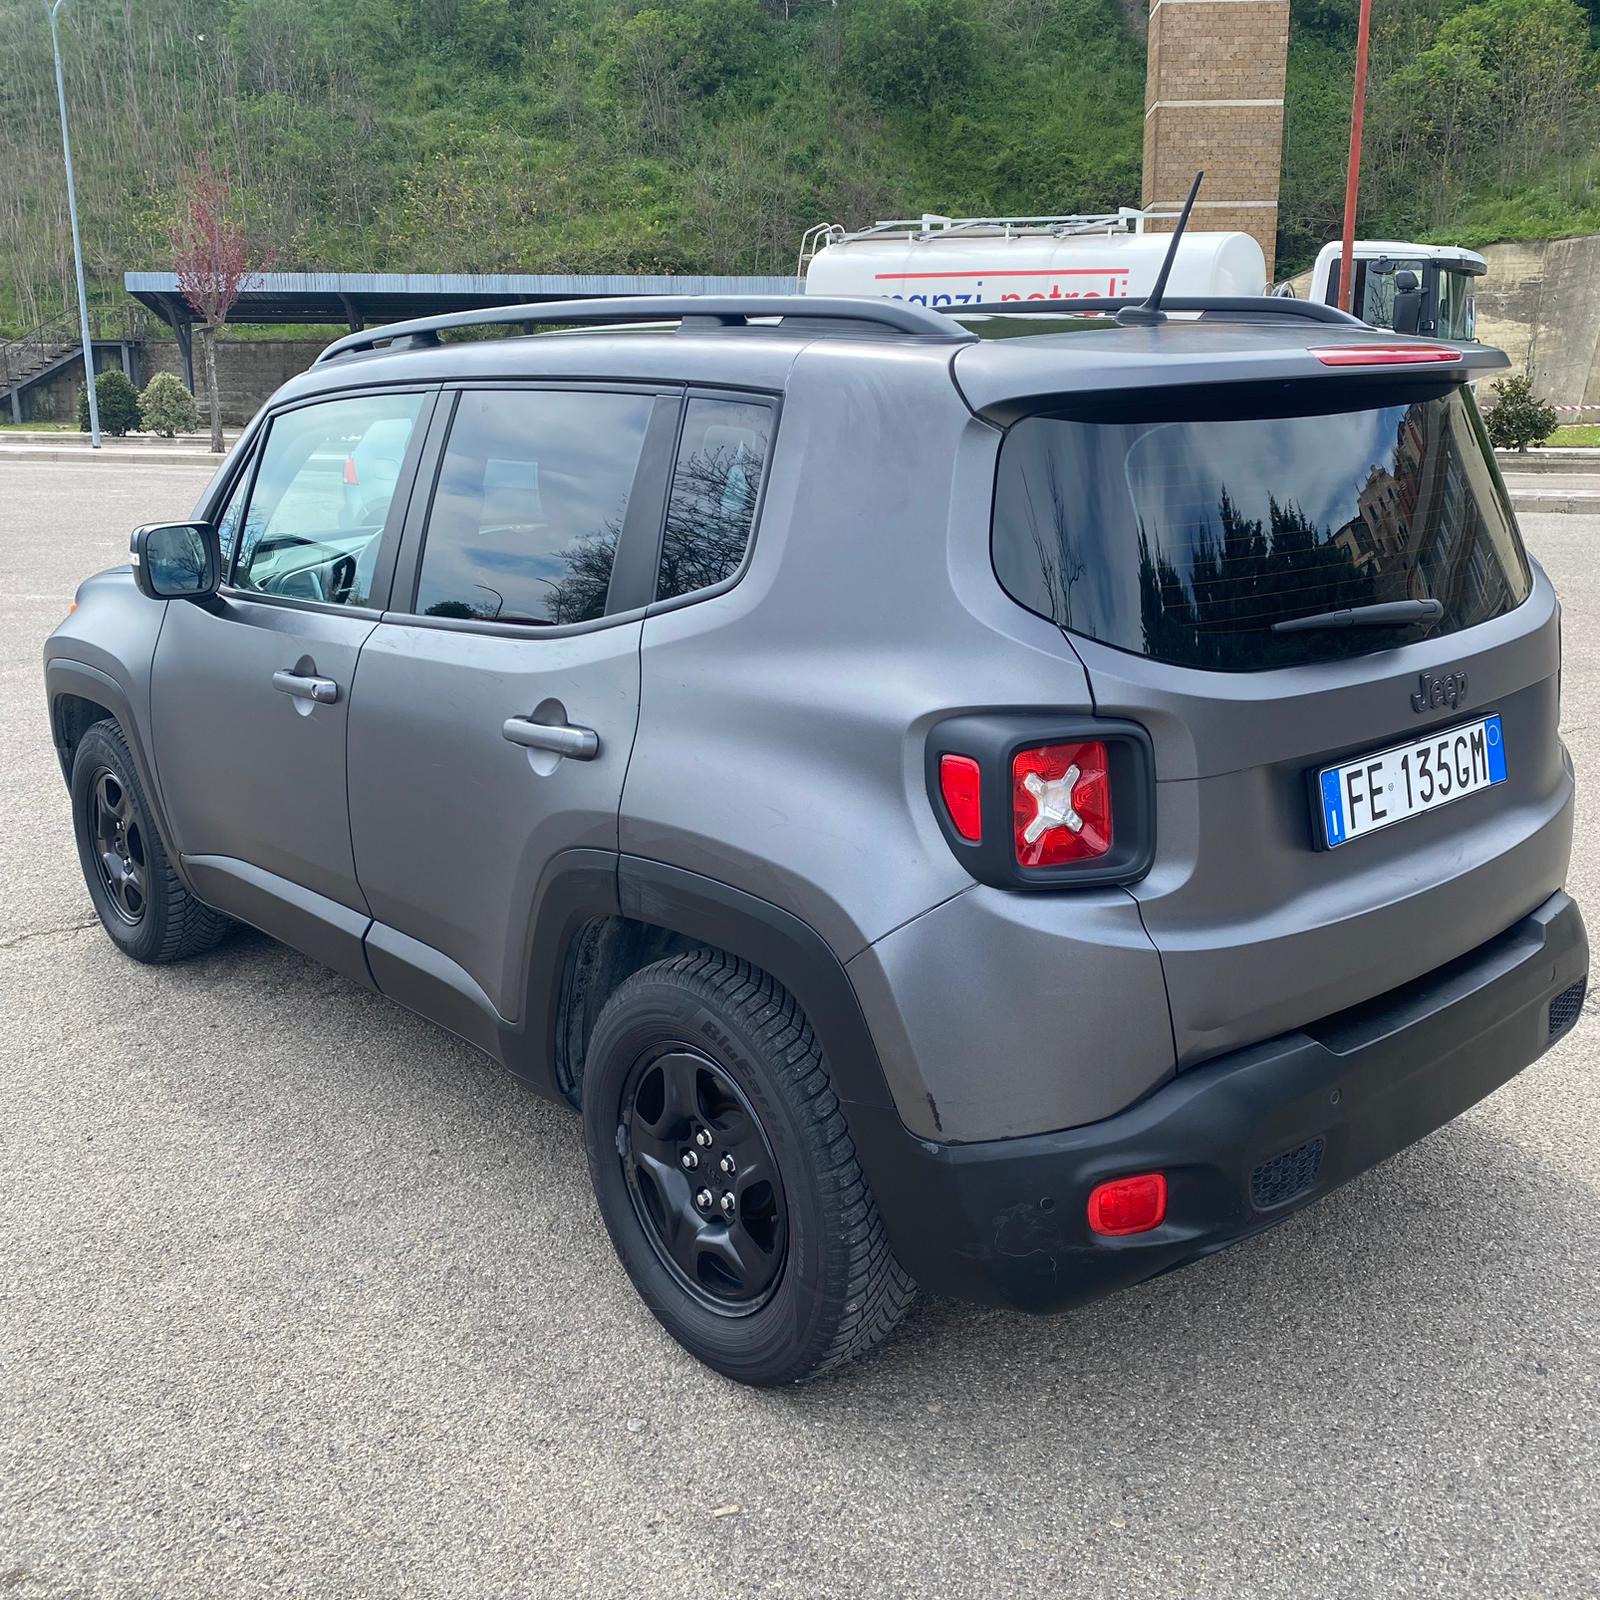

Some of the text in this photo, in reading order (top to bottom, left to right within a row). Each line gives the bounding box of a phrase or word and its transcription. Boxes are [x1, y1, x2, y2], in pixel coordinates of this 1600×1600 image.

[1411, 671, 1468, 713] Jeep
[1346, 728, 1487, 830] FE 135GM
